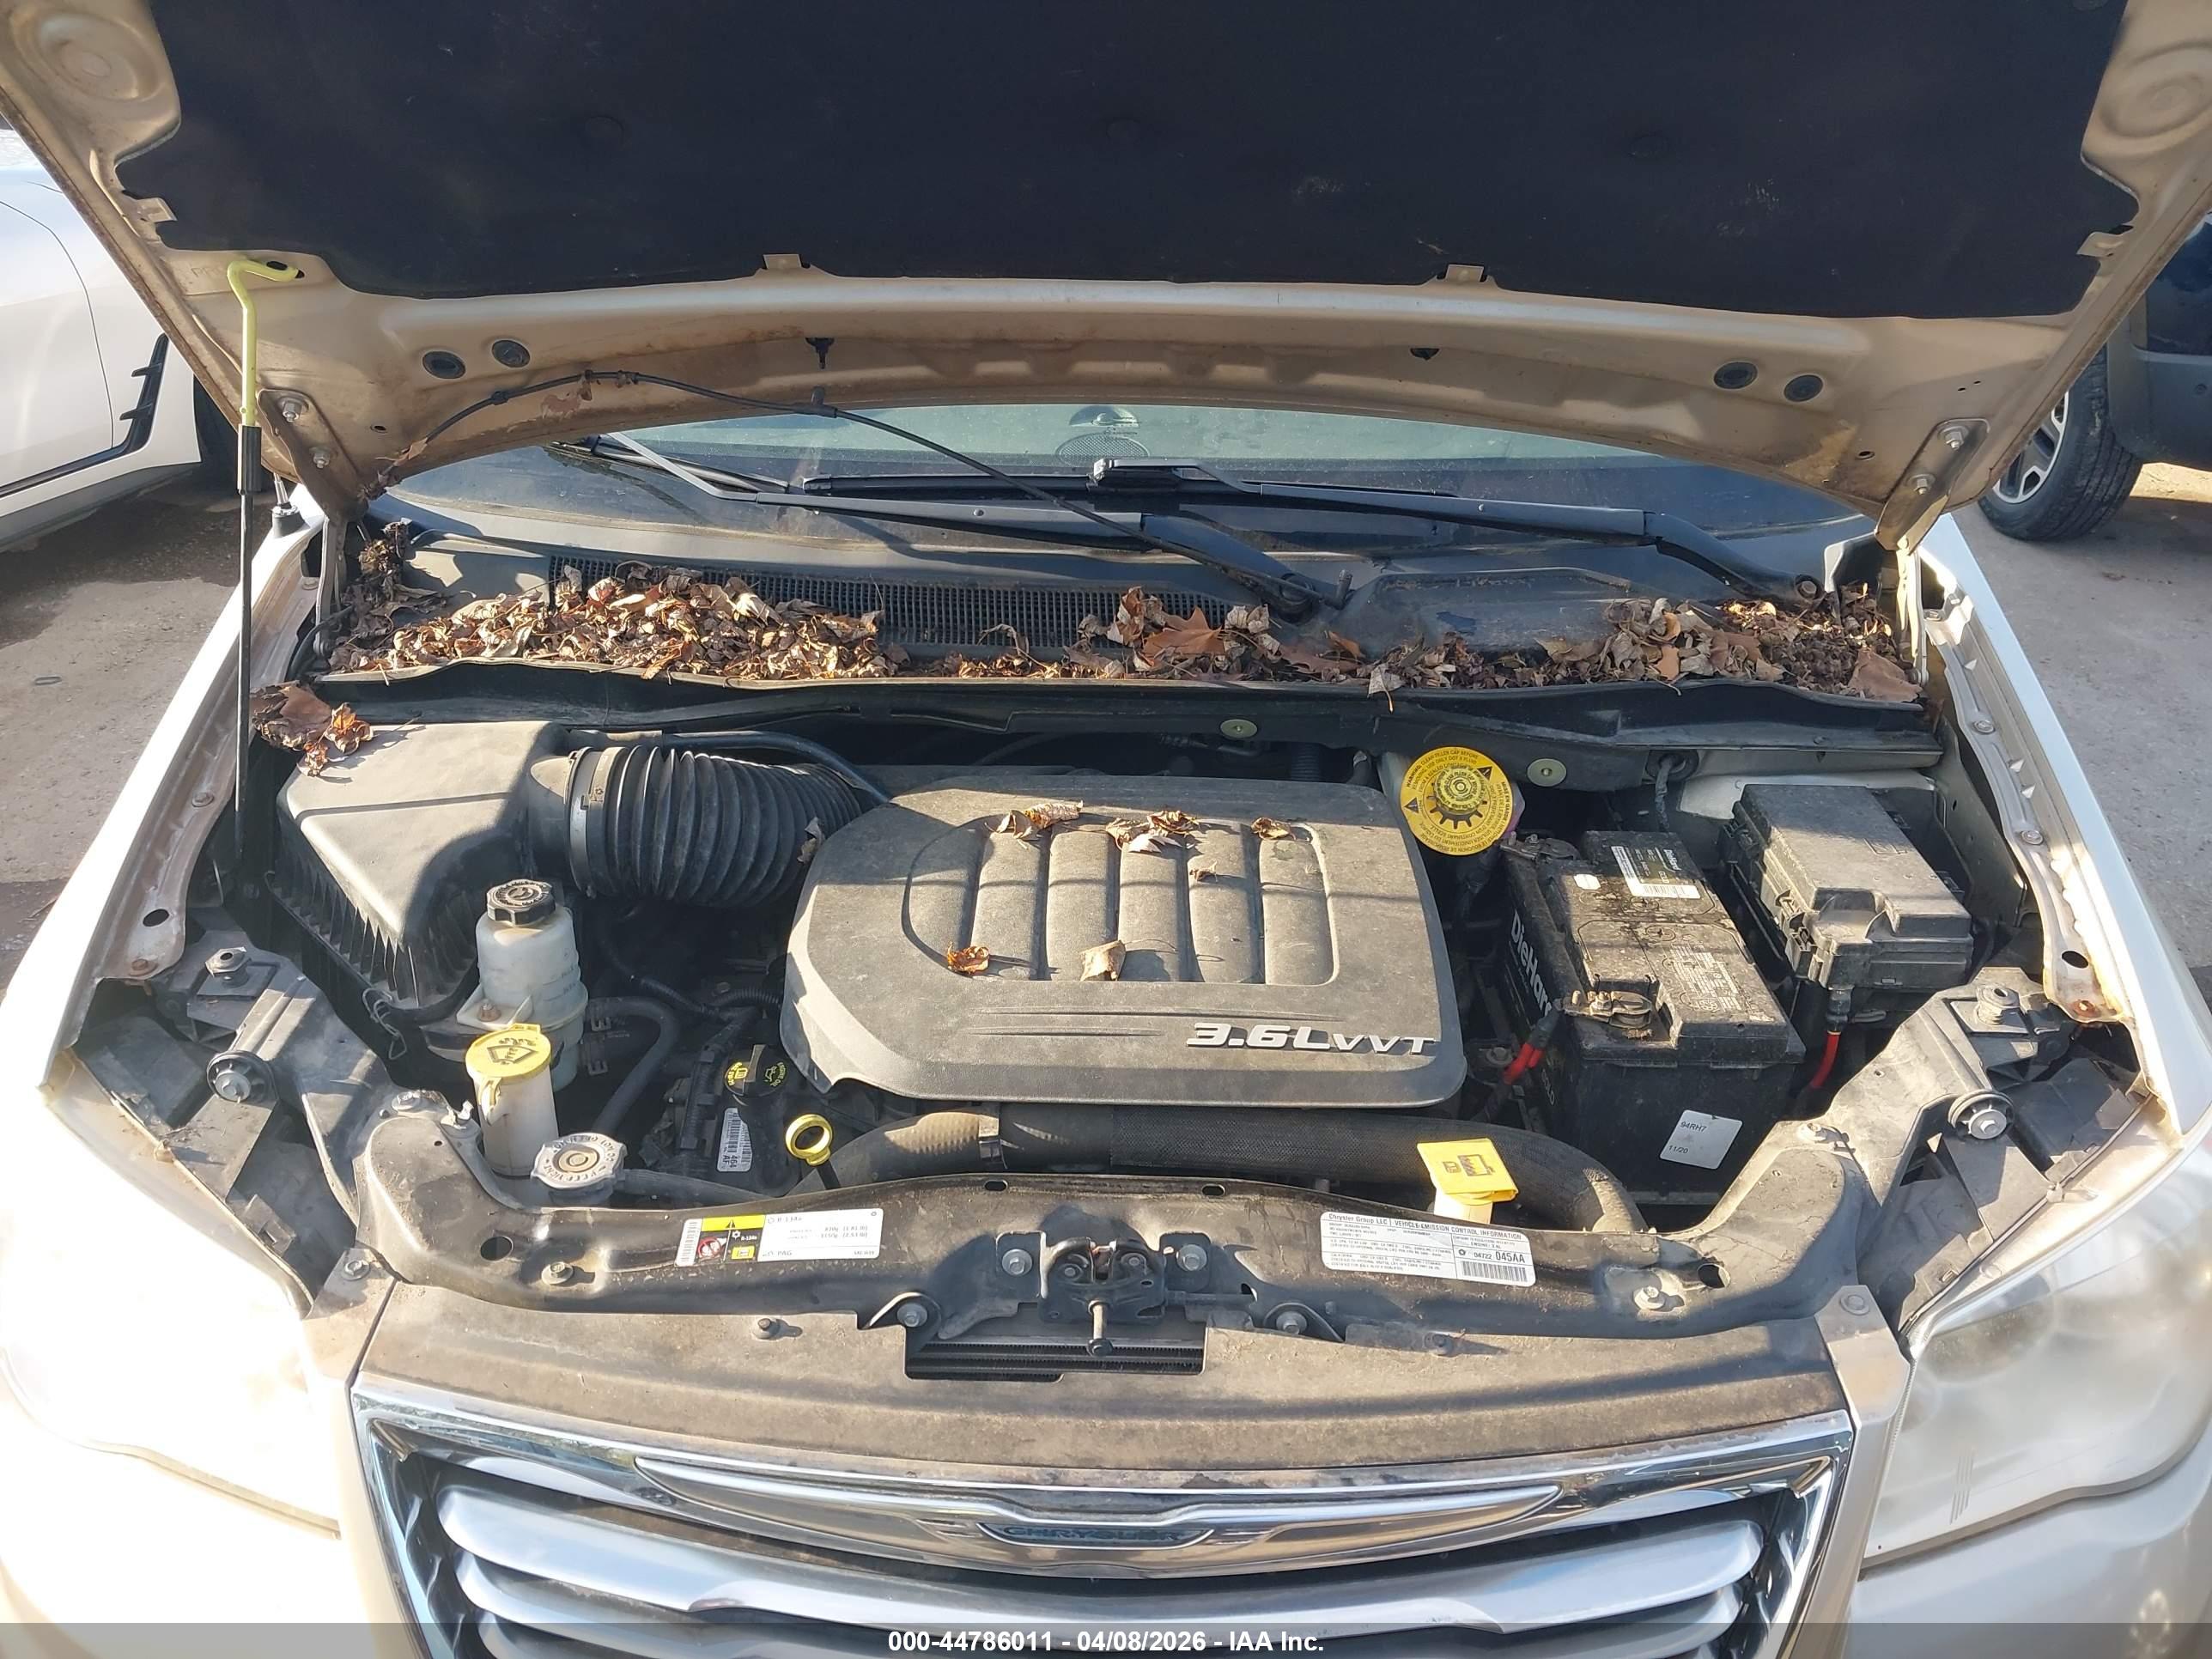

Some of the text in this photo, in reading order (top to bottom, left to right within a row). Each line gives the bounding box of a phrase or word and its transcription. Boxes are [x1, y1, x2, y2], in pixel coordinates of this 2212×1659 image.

[1187, 1023, 1435, 1054] 3.6L VVT
[1680, 1121, 1707, 1133] 94RH7
[1668, 1145, 1689, 1154] 11/20
[1328, 1213, 1354, 1224] Chrysler
[1356, 1215, 1374, 1225] Group
[1376, 1216, 1388, 1225] LLC
[1451, 1226, 1478, 1236] CONTROL
[1480, 1229, 1522, 1240] INFORMATION
[1495, 1251, 1525, 1264] 045AA
